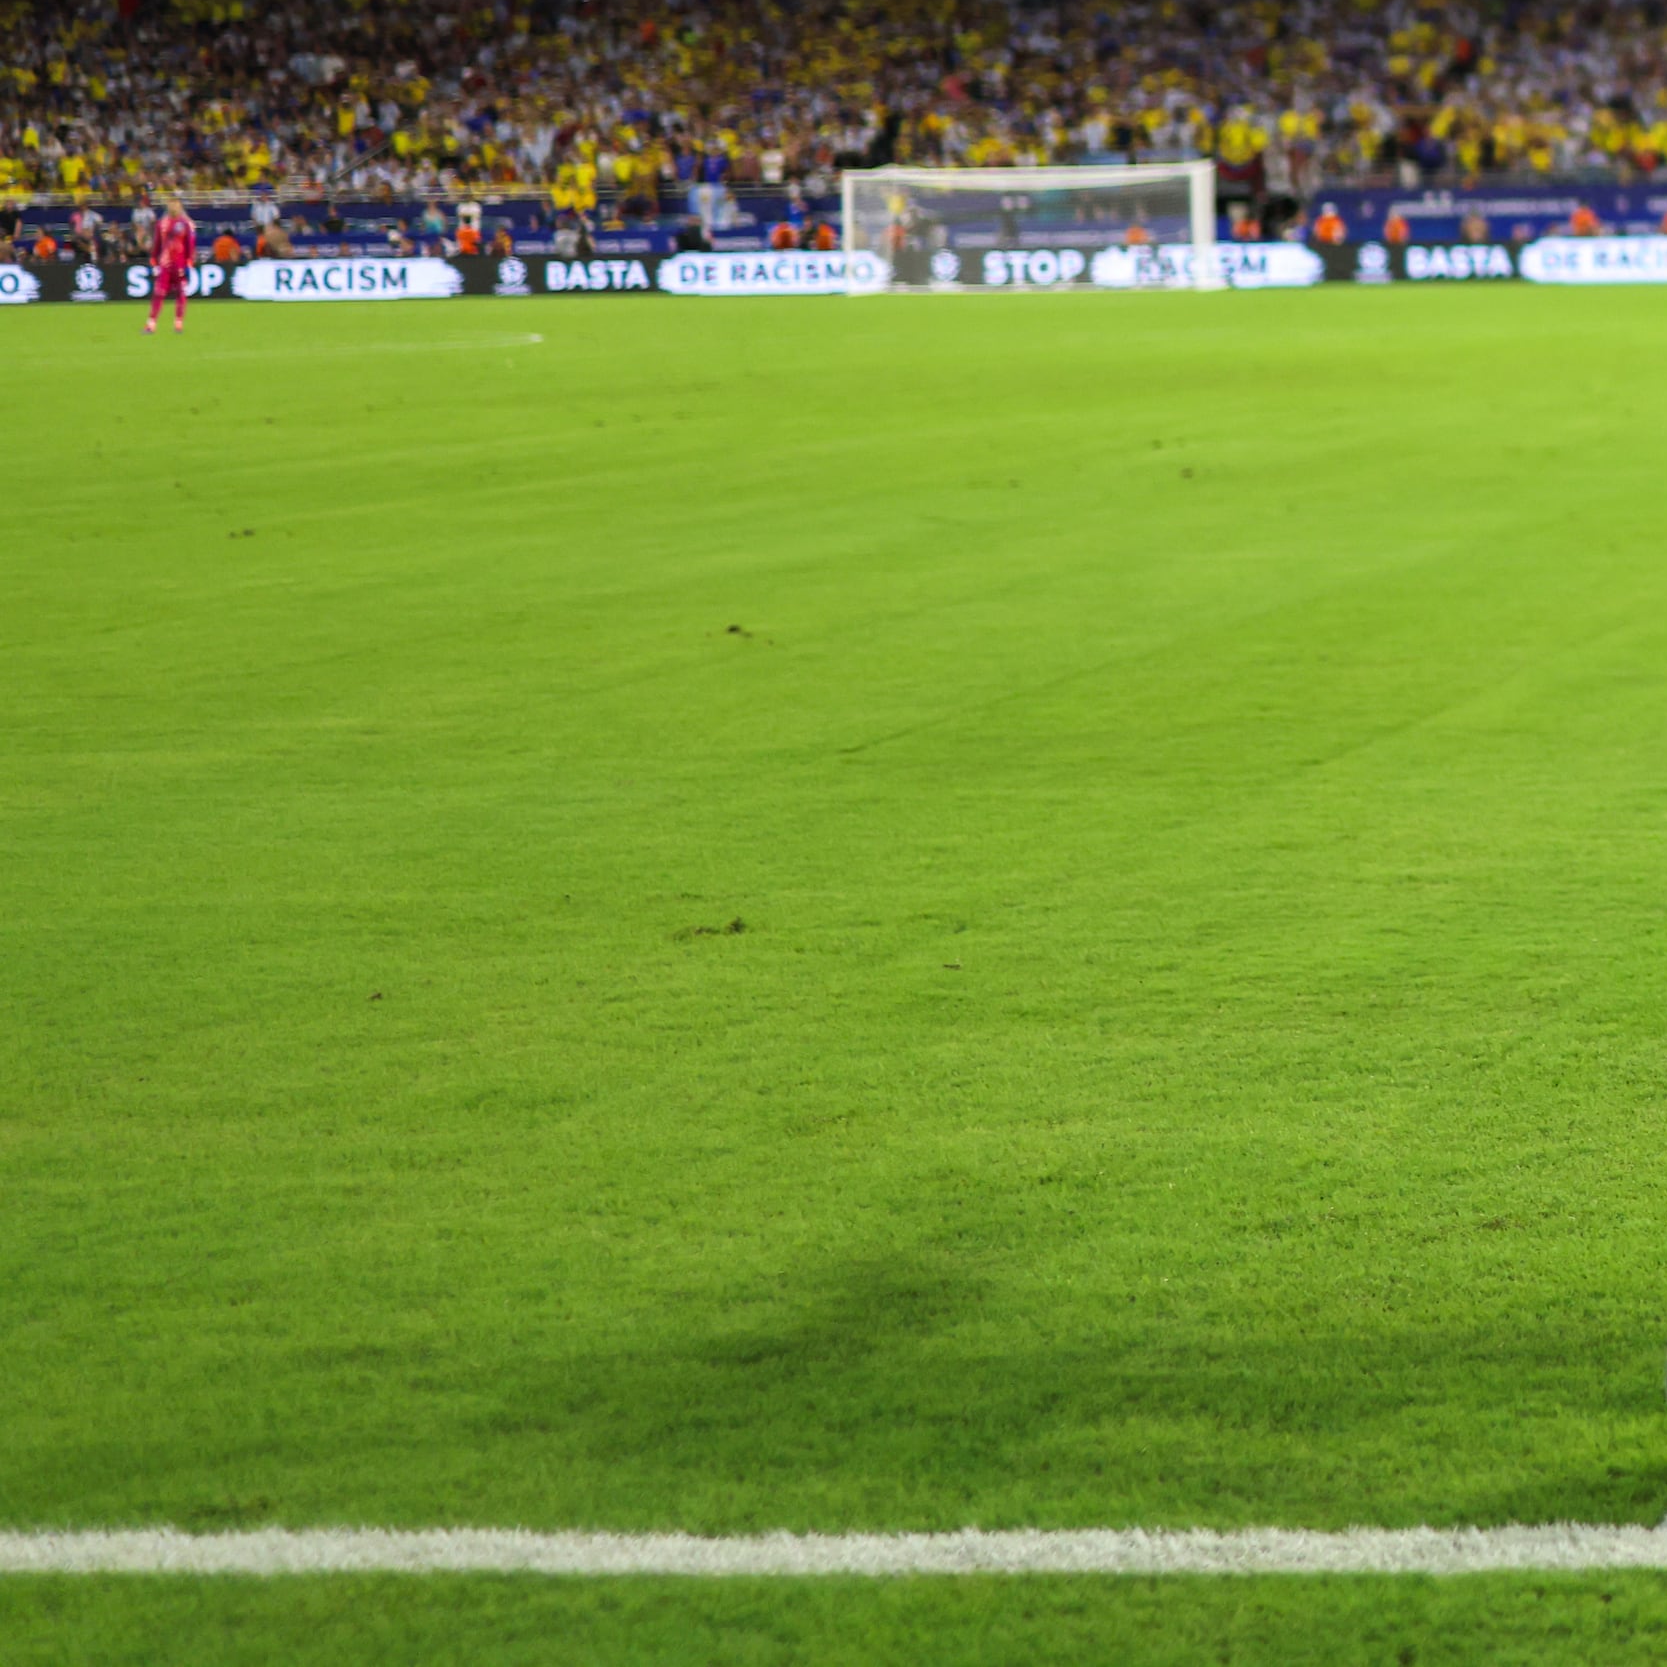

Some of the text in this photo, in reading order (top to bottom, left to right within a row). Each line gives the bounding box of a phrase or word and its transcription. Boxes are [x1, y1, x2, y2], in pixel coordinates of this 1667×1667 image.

[126, 266, 226, 299] SOP
[274, 265, 409, 294] RACISM
[545, 260, 650, 291] BASTA
[680, 261, 719, 286] DE
[983, 249, 1086, 286] STOP
[1404, 244, 1512, 281] BASTA
